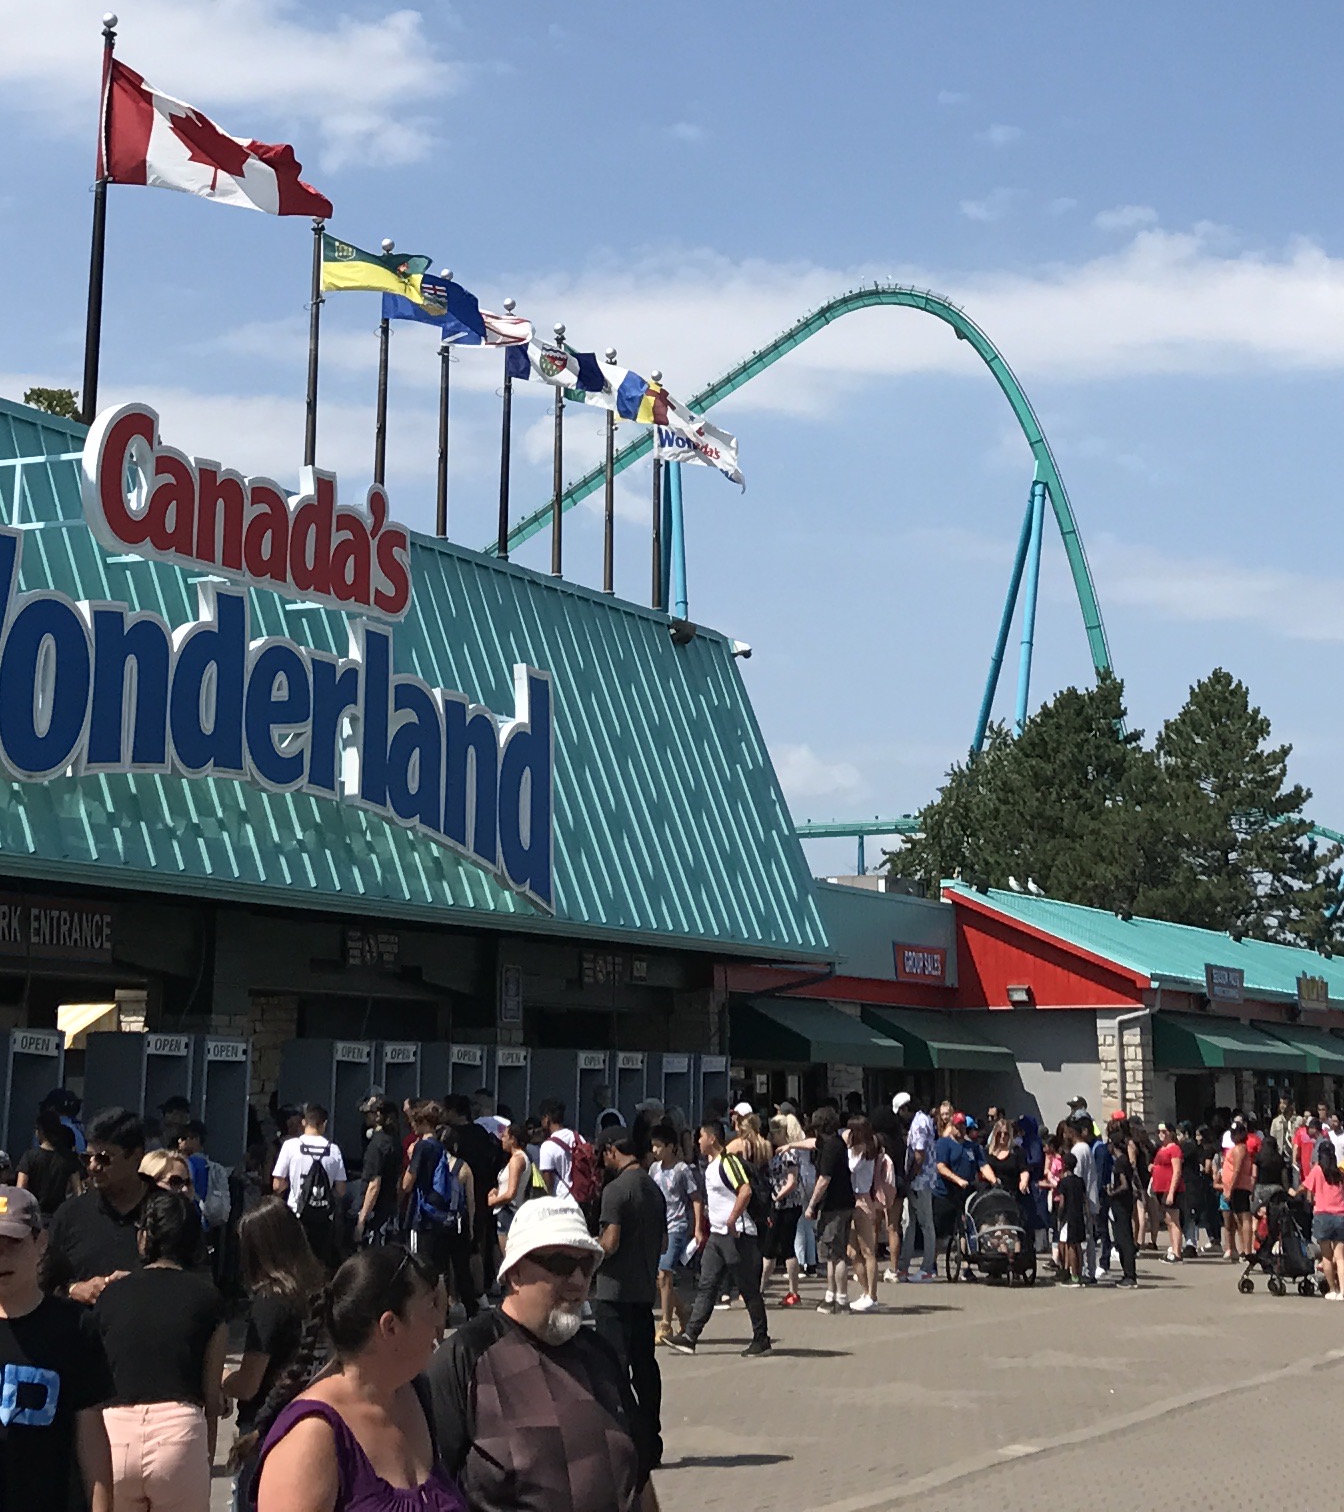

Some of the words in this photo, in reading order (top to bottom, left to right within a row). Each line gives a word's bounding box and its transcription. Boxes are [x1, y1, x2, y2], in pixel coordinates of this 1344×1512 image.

[99, 410, 409, 616] Canada's
[30, 907, 112, 950] ENTRANCE
[20, 1035, 50, 1052] OPEN
[154, 1037, 182, 1053] OPEN
[212, 1044, 239, 1058] OPEN
[341, 1047, 364, 1059] OPEN
[390, 1047, 411, 1060] OPEN
[456, 1049, 478, 1061] OPEN
[501, 1052, 521, 1063] OPEN
